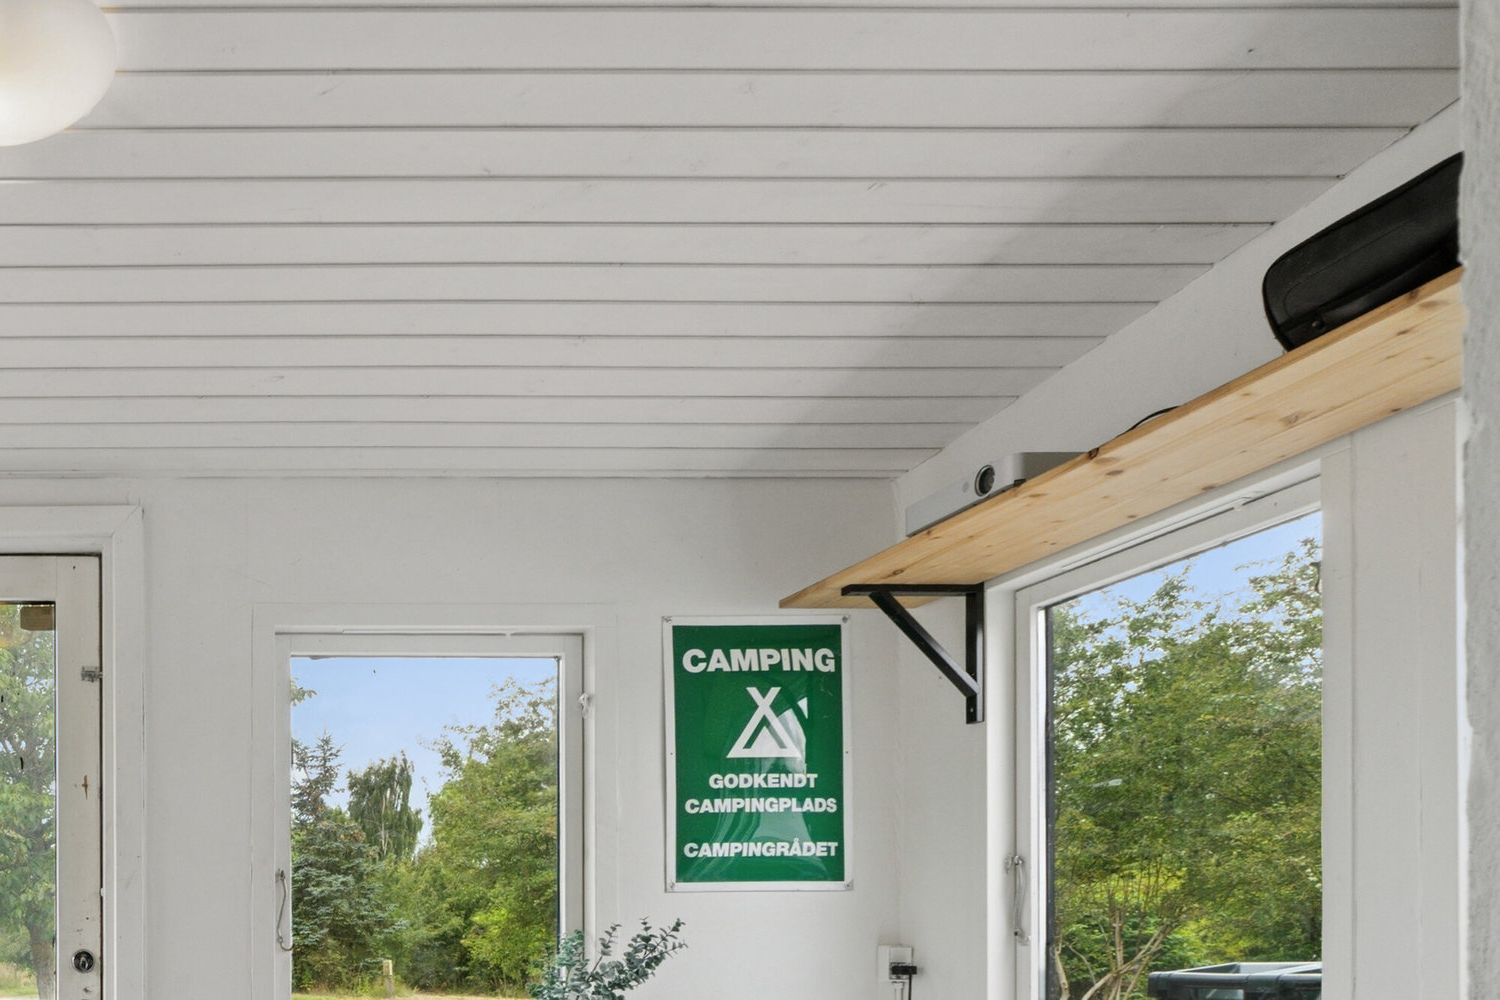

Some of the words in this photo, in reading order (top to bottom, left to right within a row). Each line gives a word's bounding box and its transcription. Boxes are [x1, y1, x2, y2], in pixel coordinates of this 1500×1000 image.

[682, 648, 836, 673] CAMPING
[709, 773, 818, 788] GODKENDT
[685, 797, 837, 814] CAMPINGPLADS
[684, 838, 838, 857] CAMPINGRÅDET
